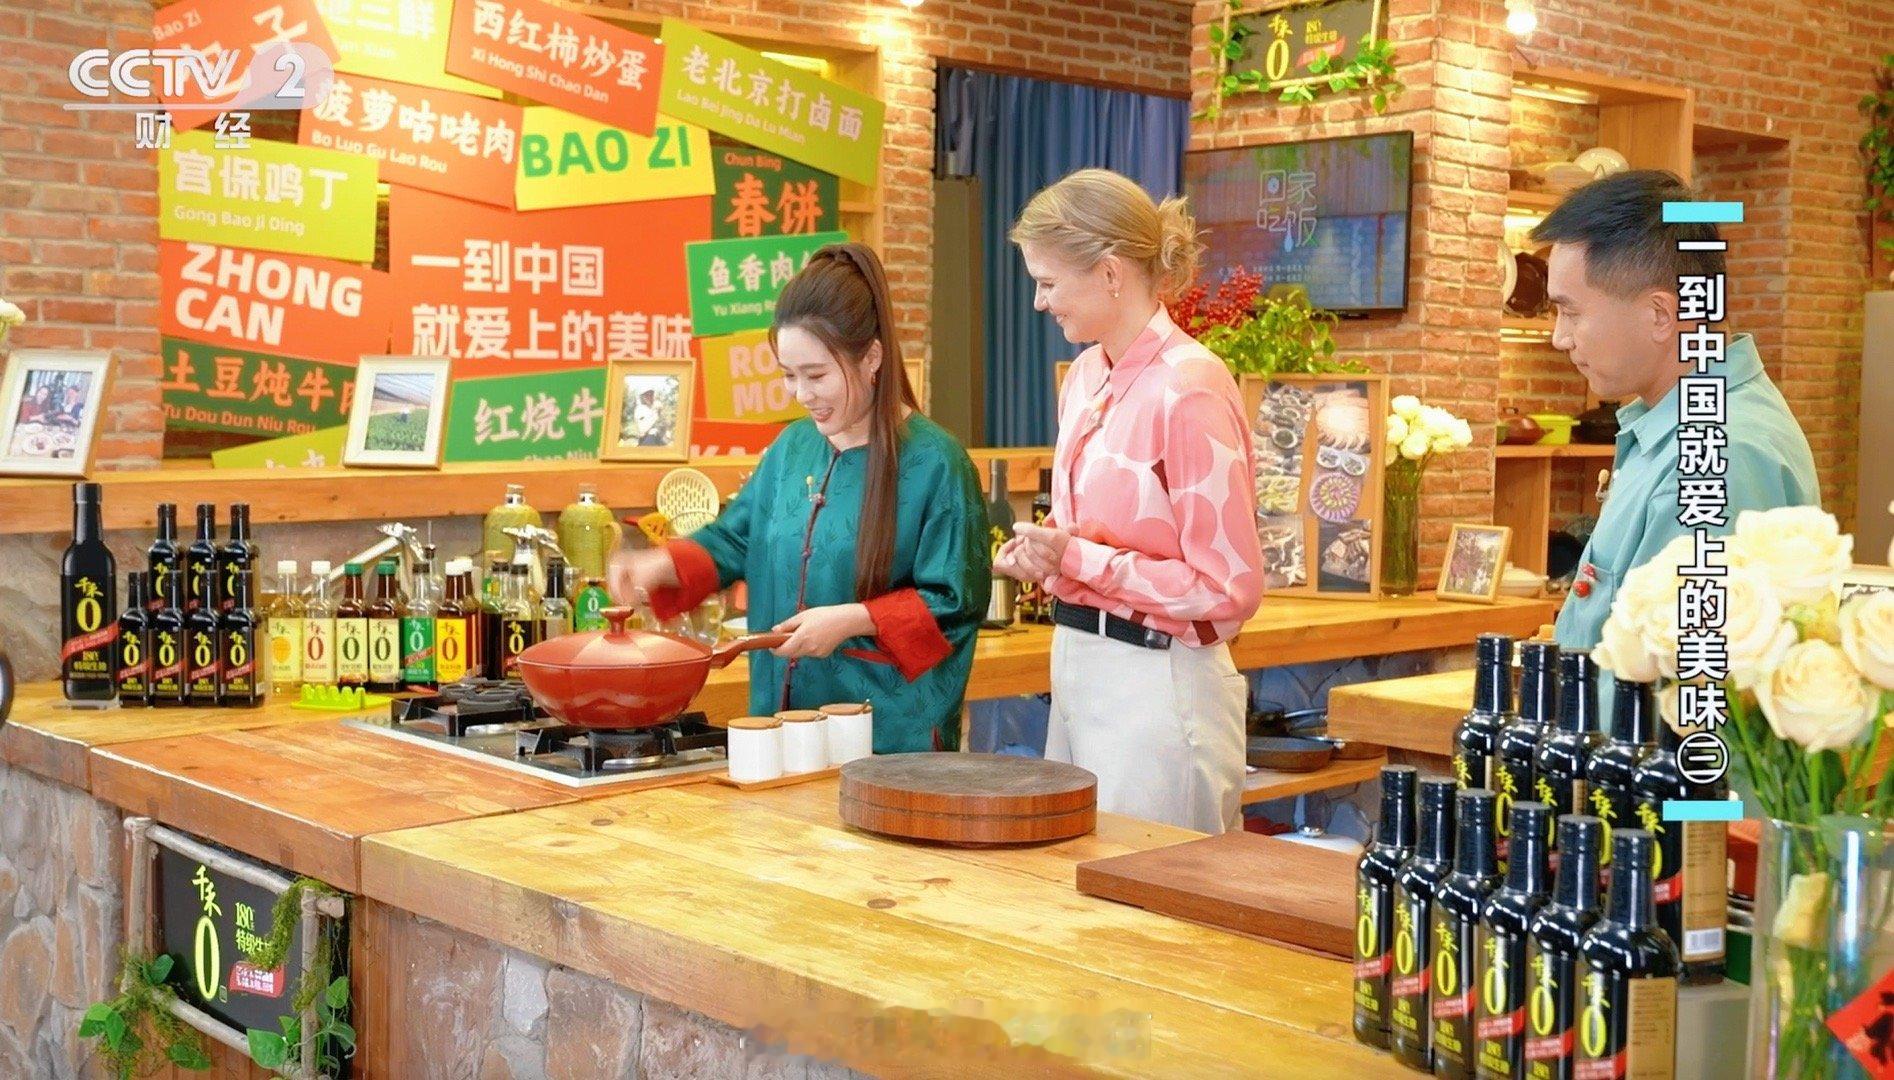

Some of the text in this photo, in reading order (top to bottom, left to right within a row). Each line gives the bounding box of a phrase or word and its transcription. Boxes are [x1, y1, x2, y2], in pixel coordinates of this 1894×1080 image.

[474, 1, 648, 91] 西红柿炒蛋
[682, 44, 863, 141] 老北京打卤面
[173, 149, 349, 211] 宫保鸡丁
[522, 125, 691, 177] BAO ZI
[724, 172, 824, 236] 春饼
[180, 242, 363, 317] ZHONG
[411, 238, 604, 298] 一到中国
[708, 251, 810, 295] 鱼香肉
[175, 287, 285, 346] CAN
[411, 303, 692, 361] 就爱上的美味
